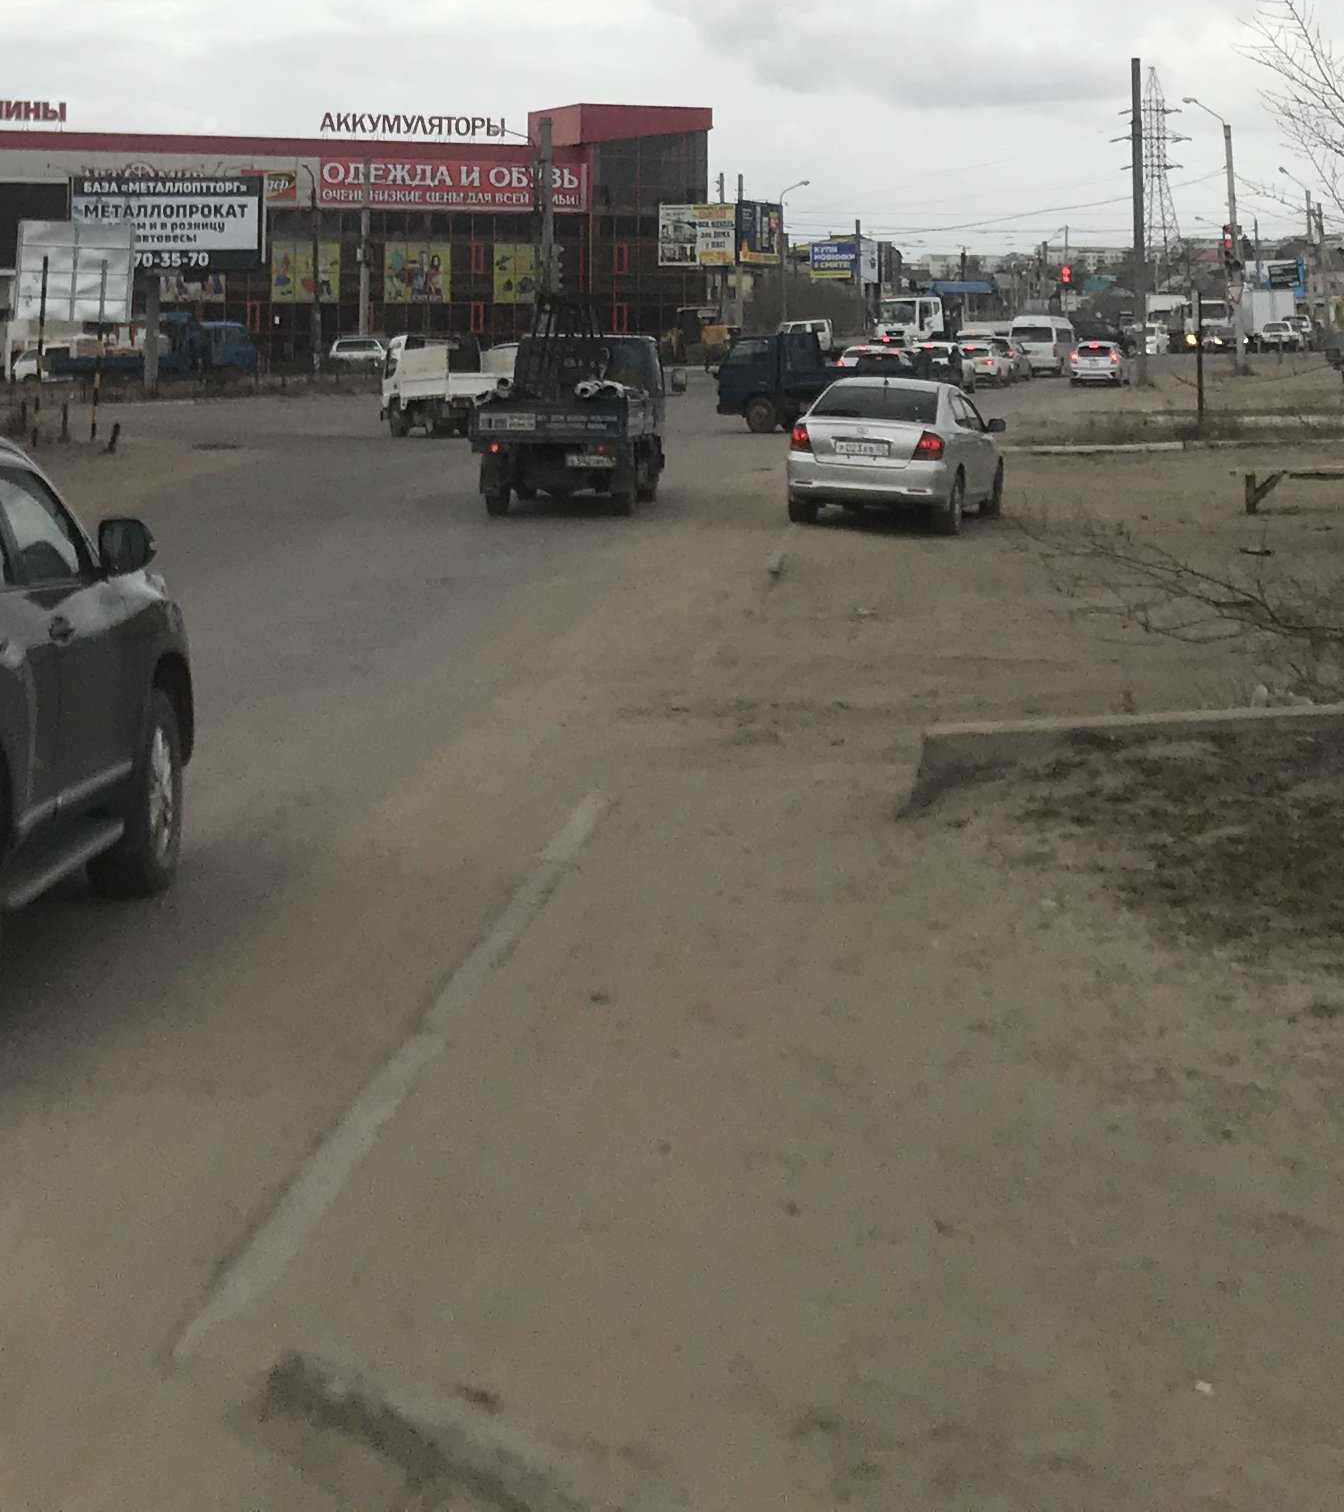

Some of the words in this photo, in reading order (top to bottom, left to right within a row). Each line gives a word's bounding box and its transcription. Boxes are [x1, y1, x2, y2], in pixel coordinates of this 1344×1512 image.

[320, 112, 505, 137] АККУМУЛЯТОРЫ
[323, 162, 453, 187] ОДЕЖДА
[460, 166, 481, 187] И
[84, 182, 118, 193] БАЗА
[369, 190, 422, 202] НИЗКИЕ
[426, 191, 464, 203] ЦЕНЫ
[467, 192, 492, 204] ДЛЯ
[496, 192, 529, 204] ВСЕЙ
[84, 204, 248, 219] МЕТАЛЛОПРОКАТ
[149, 222, 158, 230] и
[161, 222, 168, 230] в
[170, 221, 226, 233] розницу
[135, 234, 197, 243] автовесы
